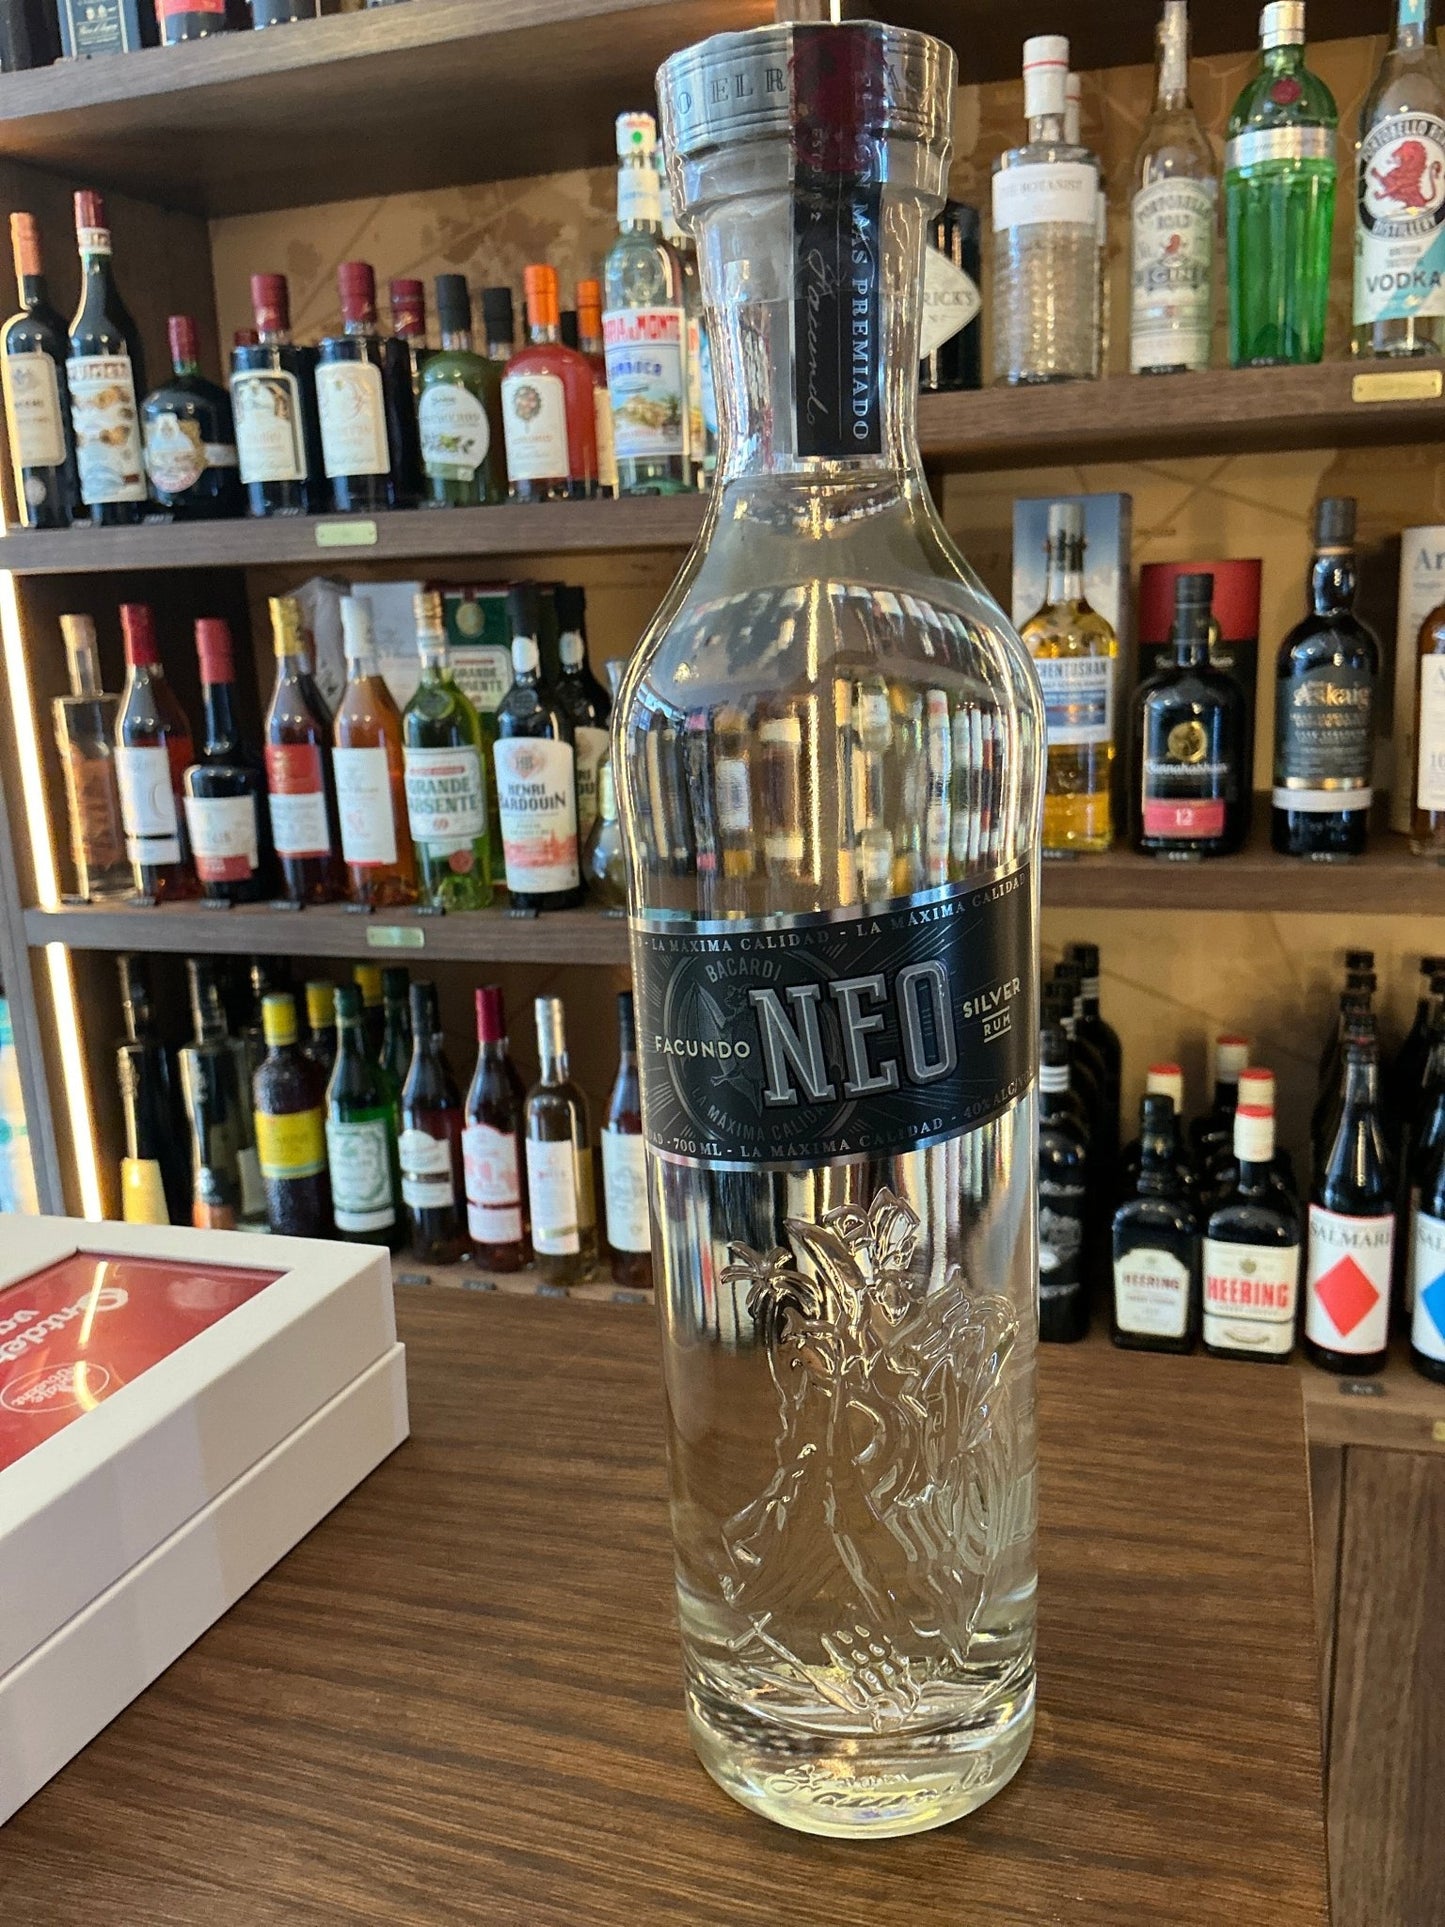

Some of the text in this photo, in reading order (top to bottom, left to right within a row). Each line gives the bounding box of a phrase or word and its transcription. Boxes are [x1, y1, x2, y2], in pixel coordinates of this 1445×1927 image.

[1366, 271, 1442, 293] VODKA
[852, 278, 870, 441] PREMIADO
[508, 783, 546, 796] HENRI
[1175, 808, 1194, 827] 12
[652, 937, 665, 951] LA
[740, 930, 830, 951] CALIDAD
[856, 920, 882, 938] LA
[971, 873, 1026, 908] CALIDAD
[962, 976, 1021, 1019] SILVER
[749, 959, 958, 1108] NEO
[983, 1012, 1012, 1037] RUM
[655, 1034, 750, 1060] FACUNDO
[673, 1137, 697, 1154] 700
[700, 1141, 722, 1156] ML
[739, 1145, 763, 1158] LA
[1206, 1274, 1290, 1309] HEERING
